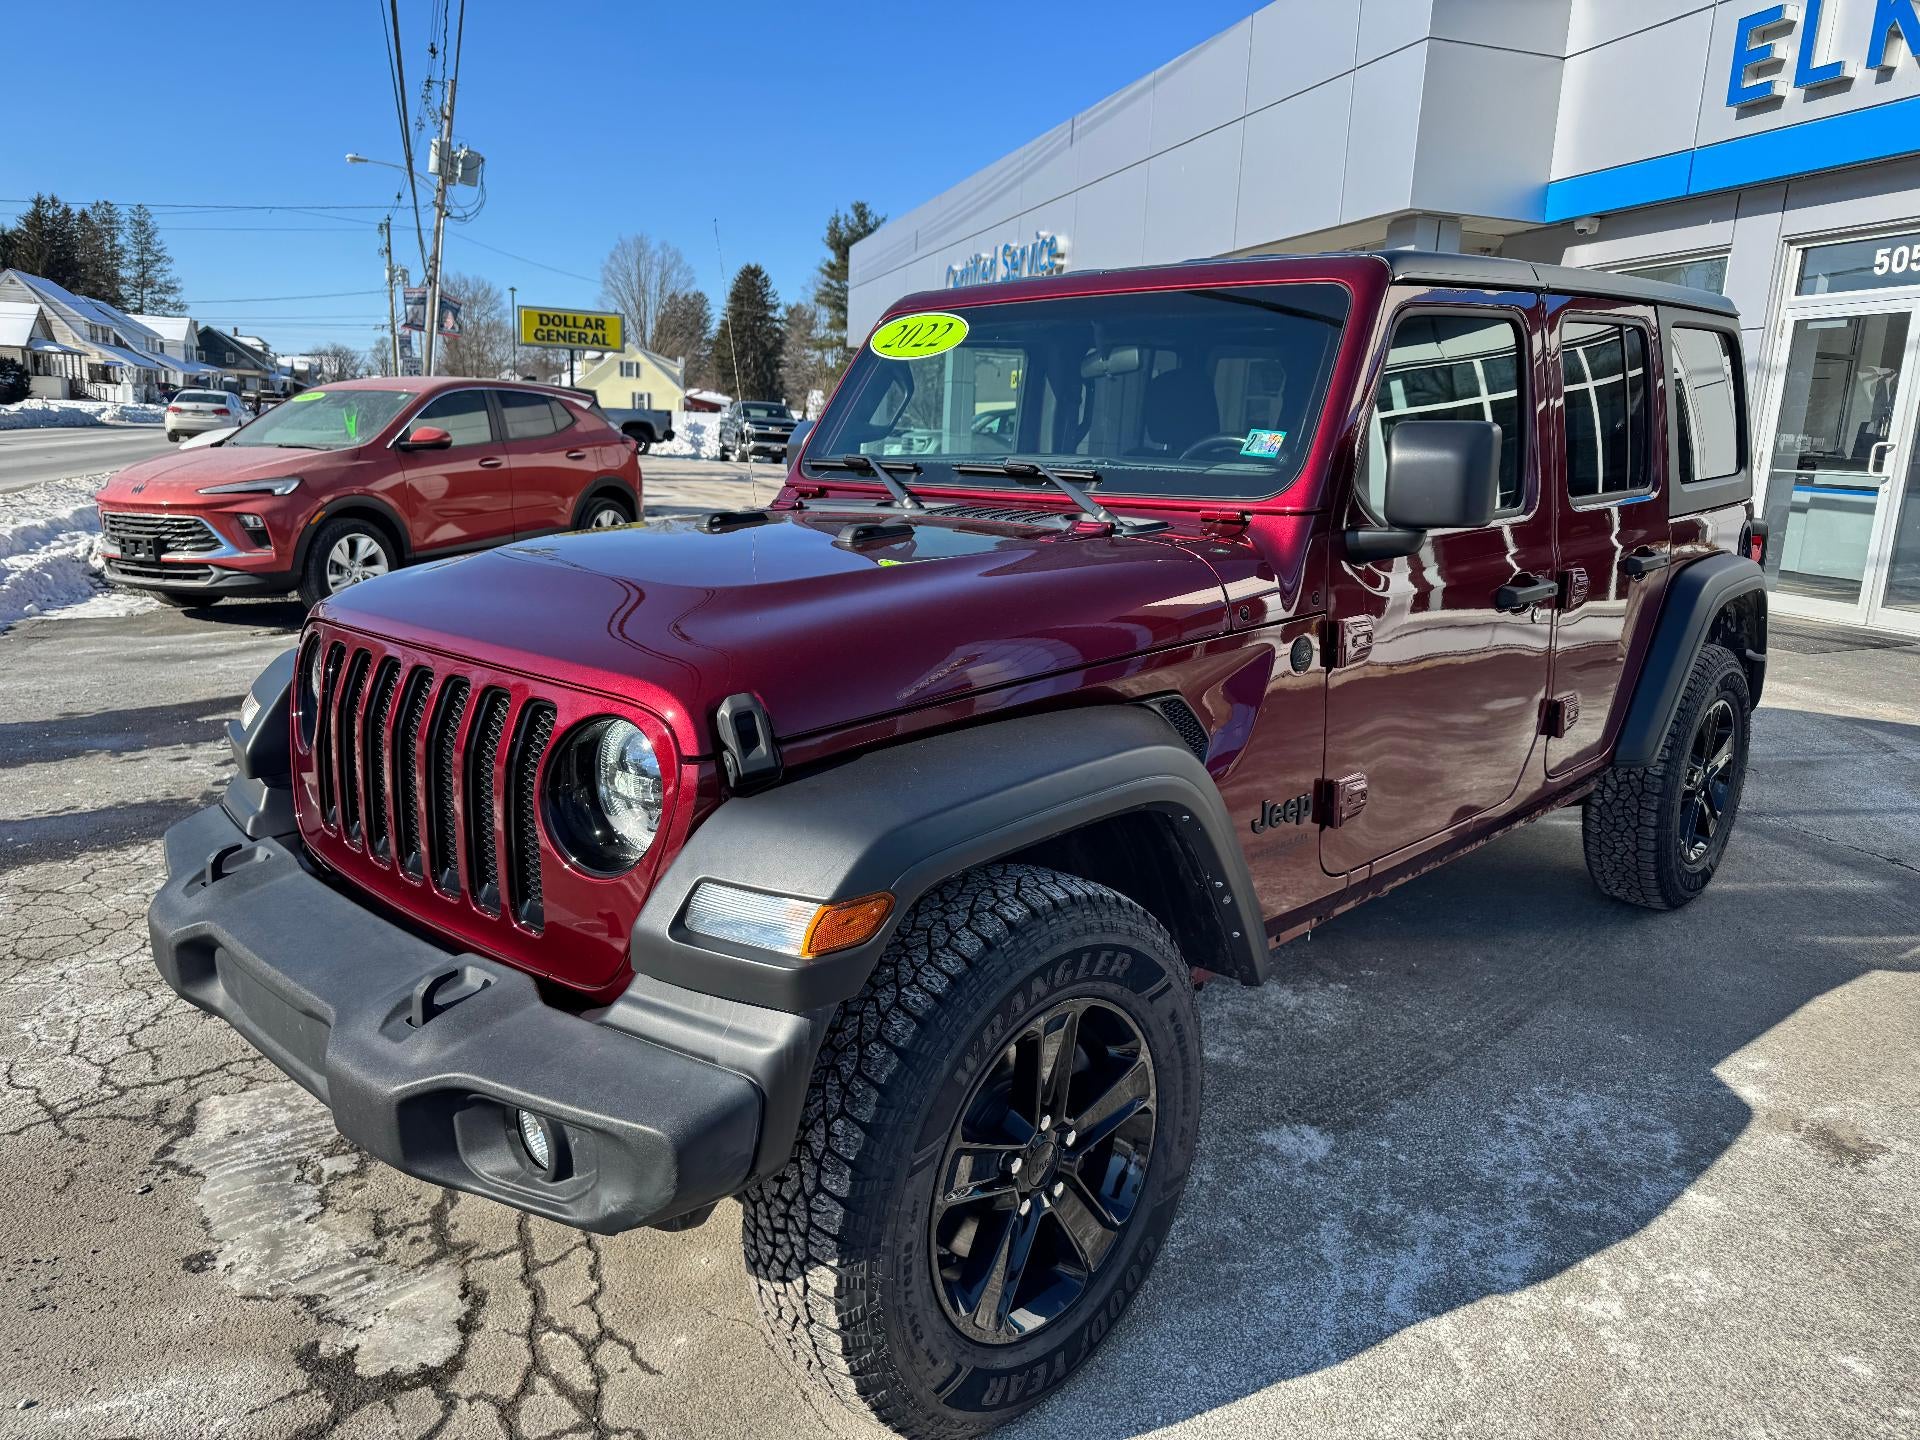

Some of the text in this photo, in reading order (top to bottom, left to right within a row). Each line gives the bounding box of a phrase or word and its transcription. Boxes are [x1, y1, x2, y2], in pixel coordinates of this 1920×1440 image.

[1726, 0, 1920, 107] ELK
[1001, 231, 1060, 281] Service
[1873, 245, 1920, 275] 505
[533, 328, 611, 346] GENERAL
[537, 313, 606, 331] DOLLAR
[881, 322, 954, 349] 2022
[1251, 792, 1313, 835] Jeep
[953, 950, 1135, 1087] WRANGLER
